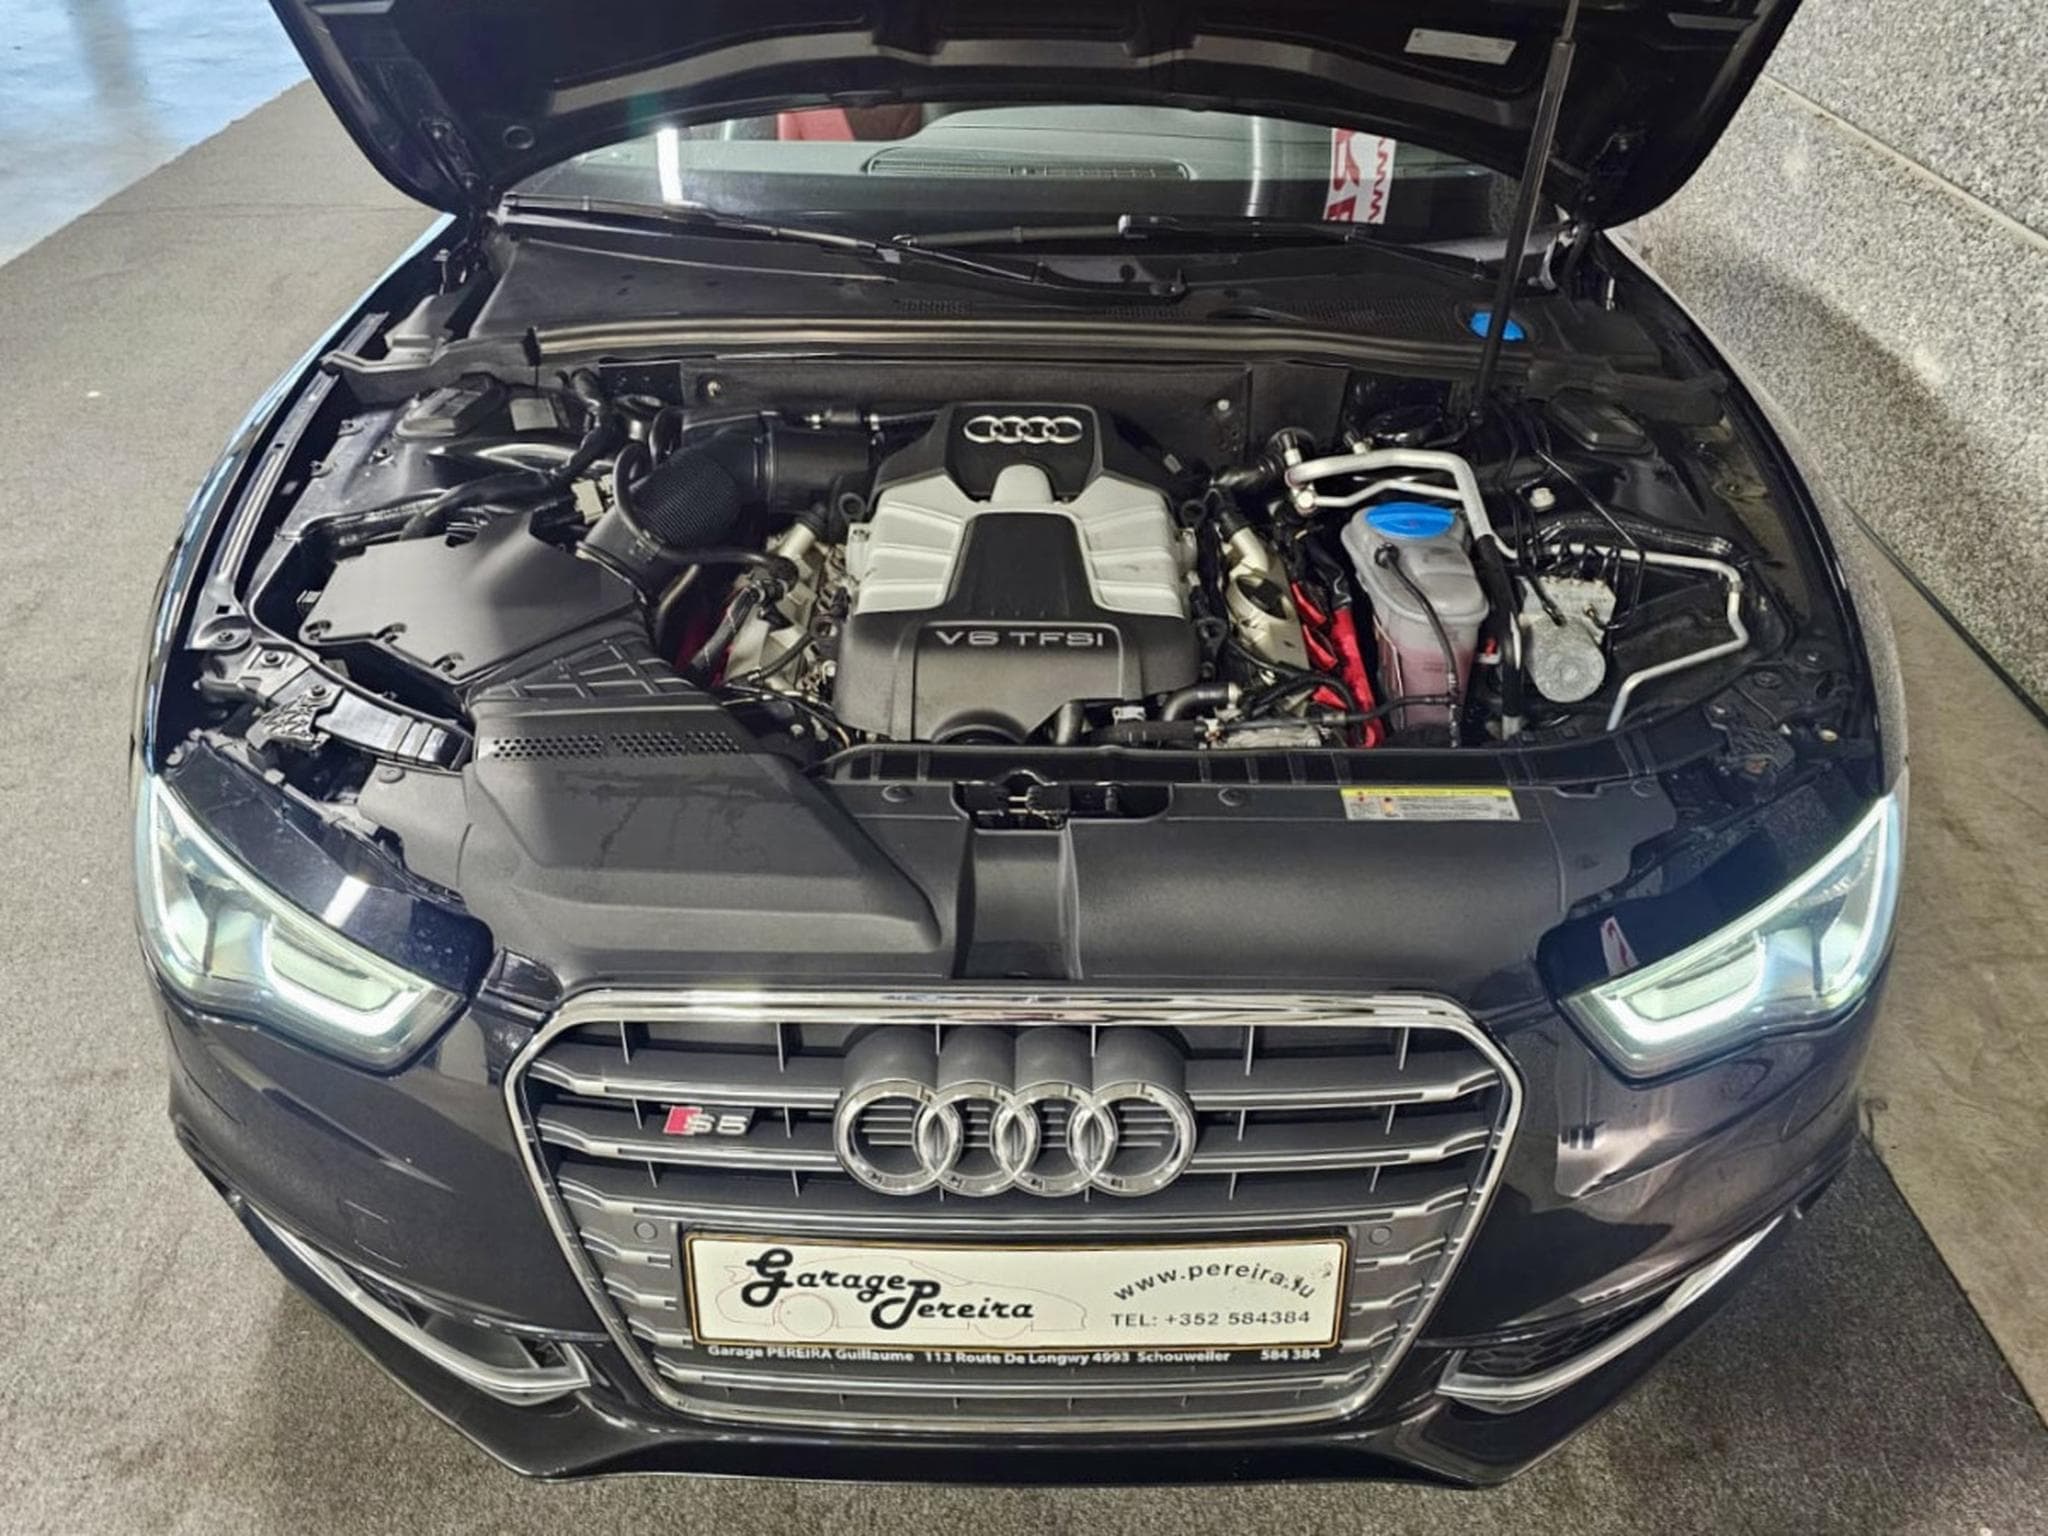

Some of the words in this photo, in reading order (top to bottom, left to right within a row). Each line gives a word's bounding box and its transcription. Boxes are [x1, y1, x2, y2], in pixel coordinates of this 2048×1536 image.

[935, 630, 999, 646] V6
[1008, 631, 1104, 647] TFSI
[741, 1247, 907, 1308] Garage
[870, 1279, 1035, 1330] Pereira
[1110, 1312, 1158, 1327] TEL:
[1165, 1312, 1219, 1327] +352
[1228, 1310, 1310, 1326] 584384
[708, 1344, 764, 1360] Garage
[767, 1346, 833, 1360] PEREIRA
[835, 1348, 915, 1362] Guillaume
[925, 1351, 952, 1363] 113
[954, 1352, 1000, 1364] Route
[1004, 1352, 1026, 1364] De
[1028, 1352, 1090, 1366] Longwy
[1092, 1350, 1130, 1363] 4993
